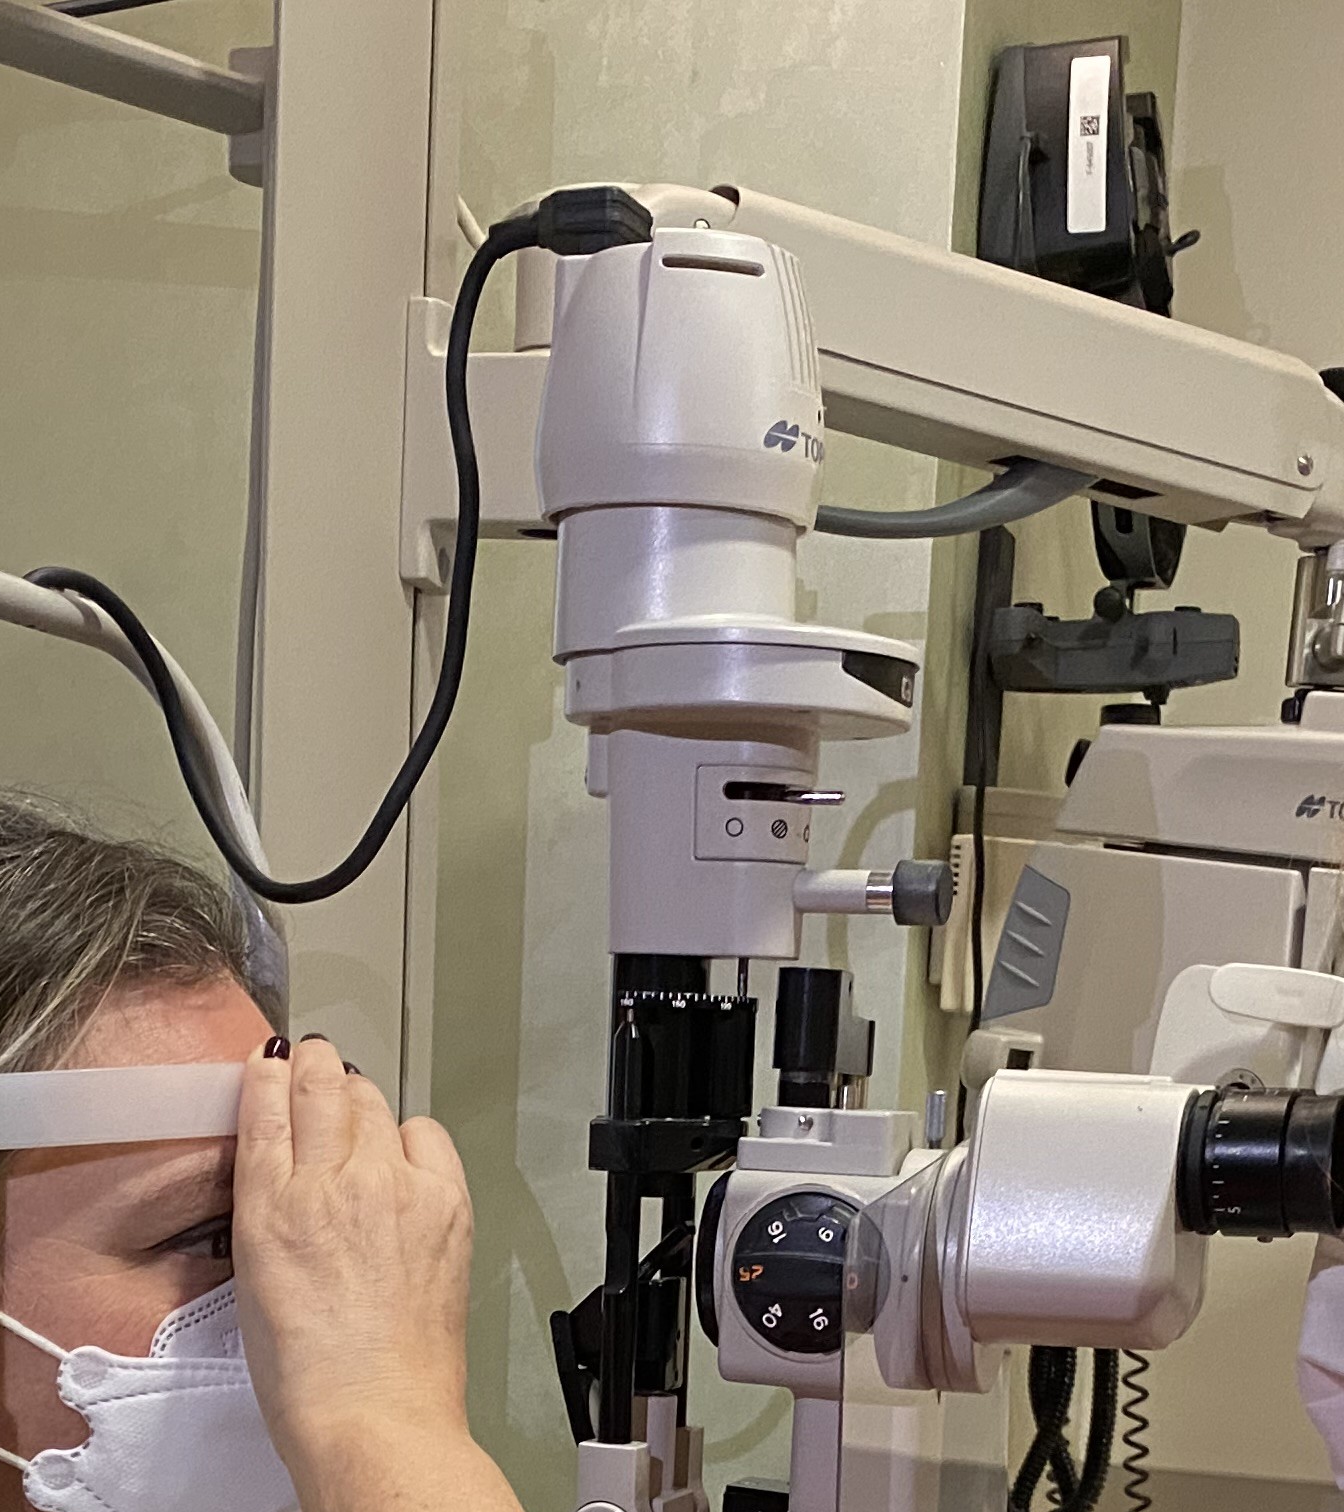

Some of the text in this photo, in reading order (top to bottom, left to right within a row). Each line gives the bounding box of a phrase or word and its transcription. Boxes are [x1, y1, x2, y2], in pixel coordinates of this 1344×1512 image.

[767, 1220, 788, 1244] 16
[738, 1264, 764, 1282] 25
[762, 1303, 783, 1329] 40
[808, 1307, 829, 1331] 16
